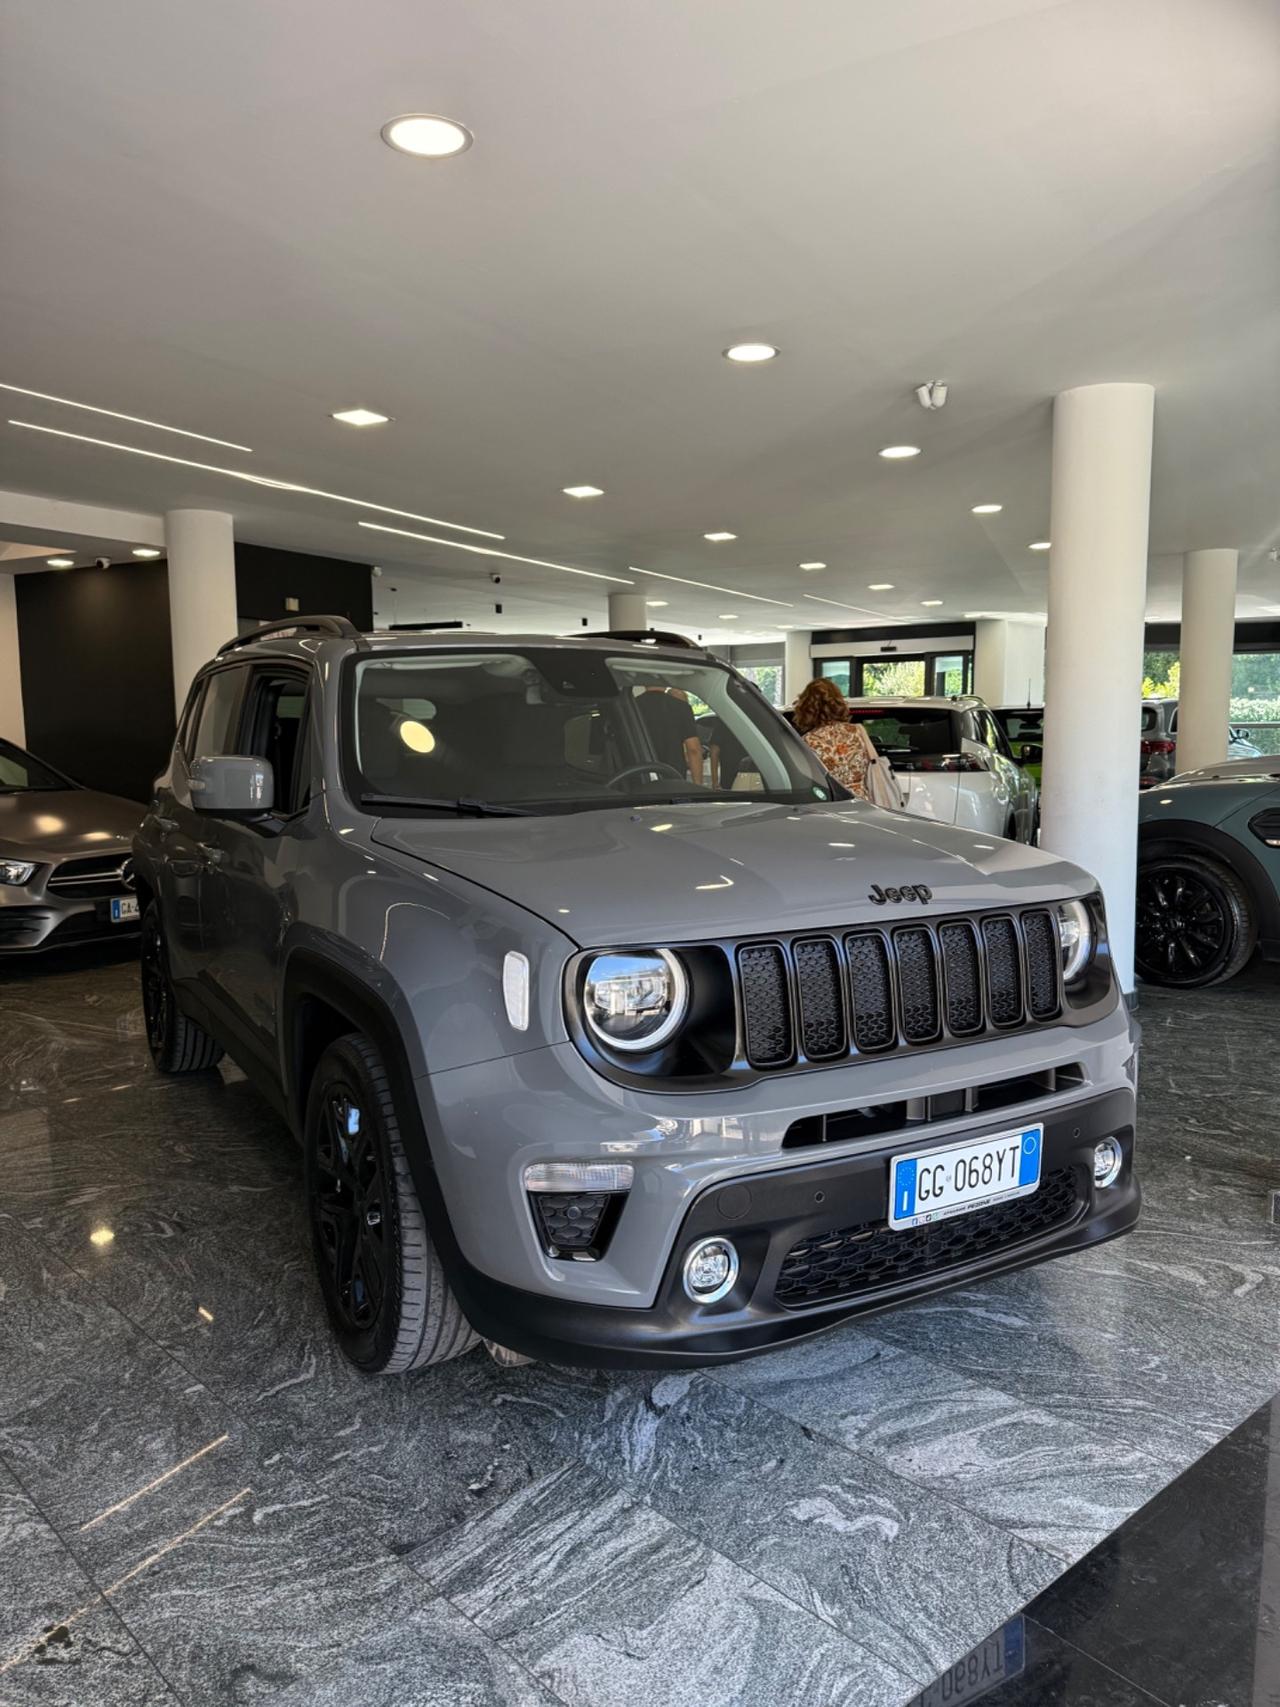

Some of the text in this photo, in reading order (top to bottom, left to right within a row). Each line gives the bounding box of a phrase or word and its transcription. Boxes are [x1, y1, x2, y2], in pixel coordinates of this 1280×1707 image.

[868, 884, 933, 905] Jeep
[918, 1164, 945, 1201] GG
[954, 1145, 1020, 1192] 068YT
